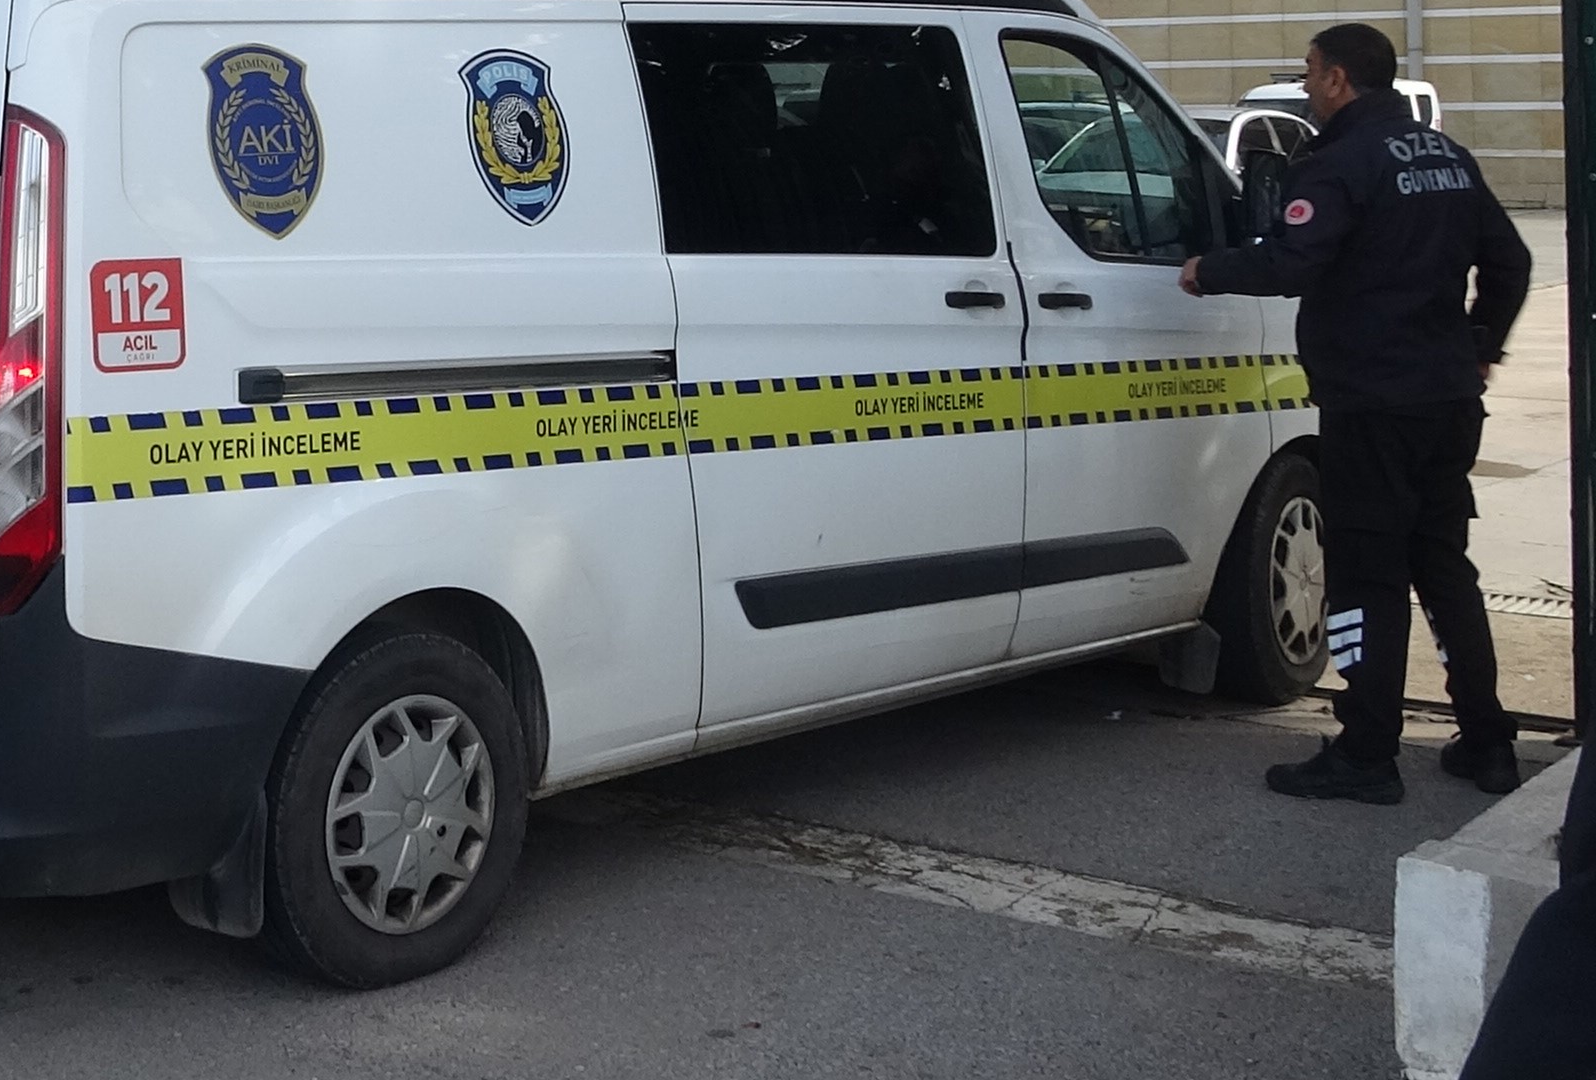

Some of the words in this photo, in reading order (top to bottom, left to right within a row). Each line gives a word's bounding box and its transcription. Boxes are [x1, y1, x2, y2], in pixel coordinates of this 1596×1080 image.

[238, 119, 295, 154] AKİ
[1385, 132, 1459, 162] ÖZEL
[104, 271, 171, 324] 112
[855, 398, 888, 416] OLAY
[891, 392, 919, 414] YERİ
[923, 391, 984, 412] İNCELEME
[1128, 382, 1153, 398] OLAY
[536, 417, 577, 437] OLAY
[582, 409, 617, 434] YERİ
[622, 409, 699, 432] İNCELEME
[150, 441, 203, 465] OLAY
[209, 432, 254, 460] YERİ
[262, 430, 361, 457] İNCELEME
